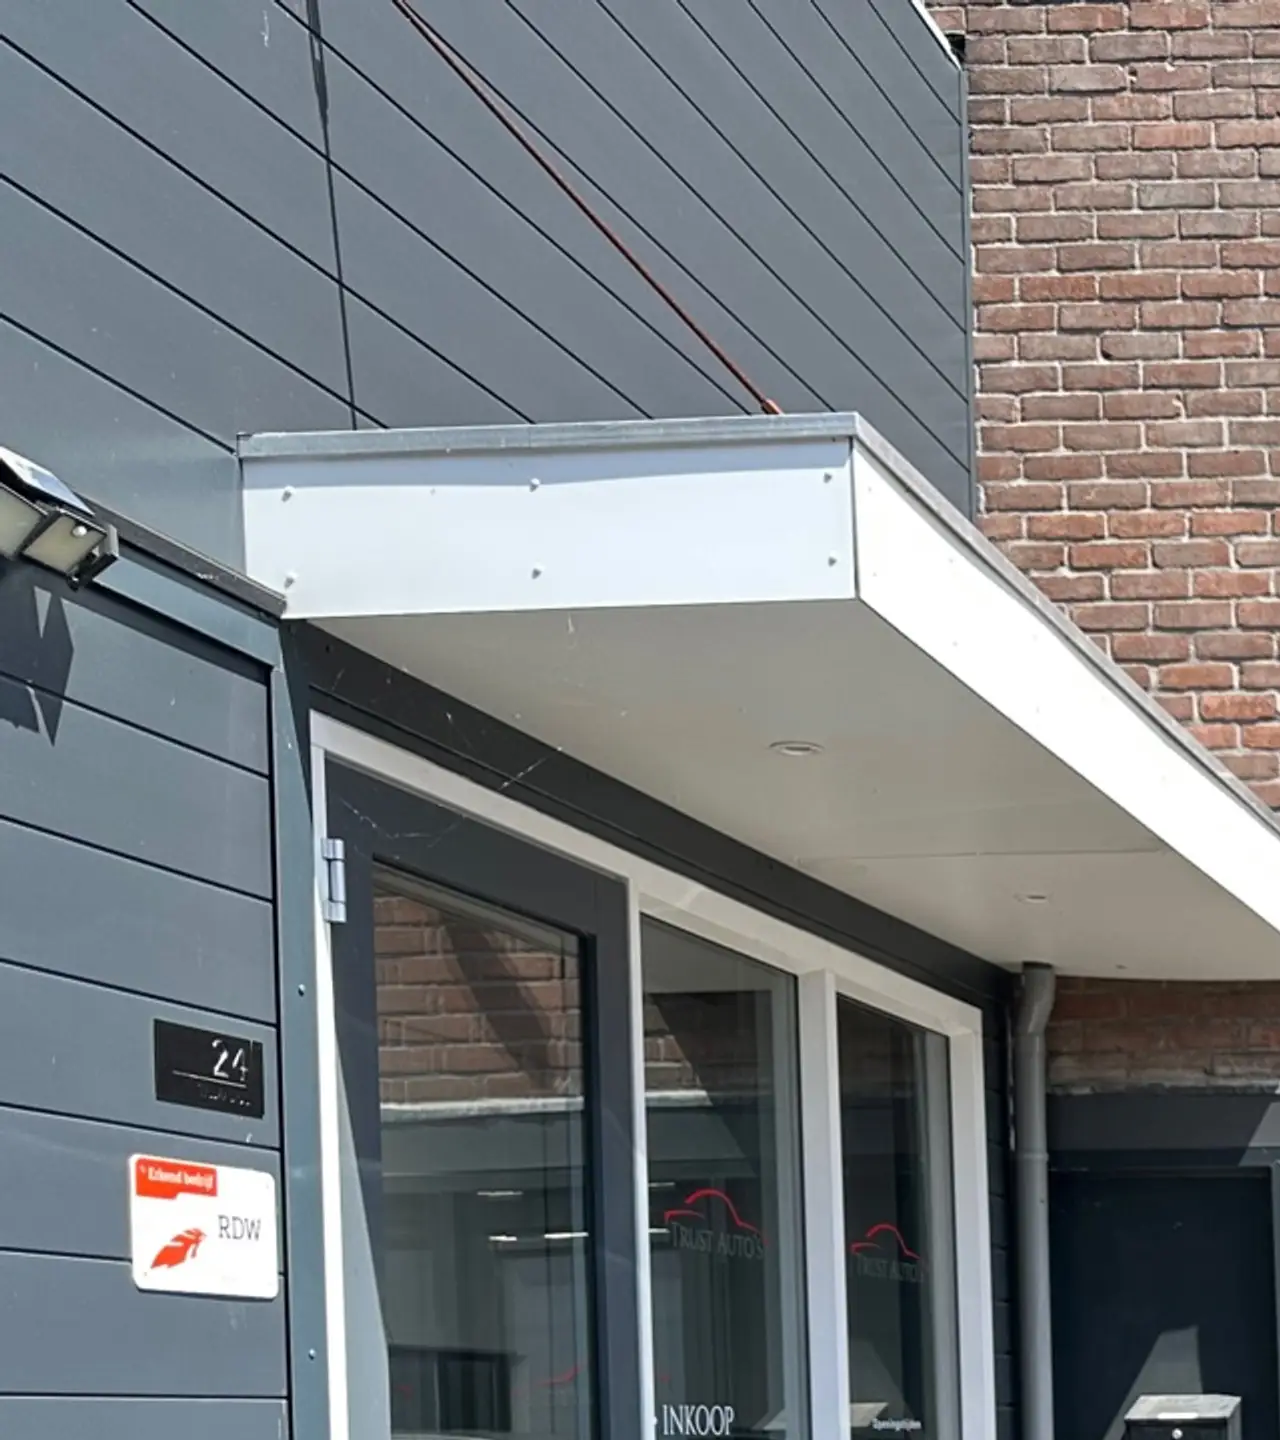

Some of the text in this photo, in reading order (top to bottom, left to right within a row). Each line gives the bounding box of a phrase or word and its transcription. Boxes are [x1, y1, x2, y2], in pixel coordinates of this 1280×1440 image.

[211, 1039, 249, 1081] 24
[217, 1214, 262, 1241] RDW
[670, 1221, 713, 1251] TRUST
[662, 1404, 735, 1435] INKOOP
